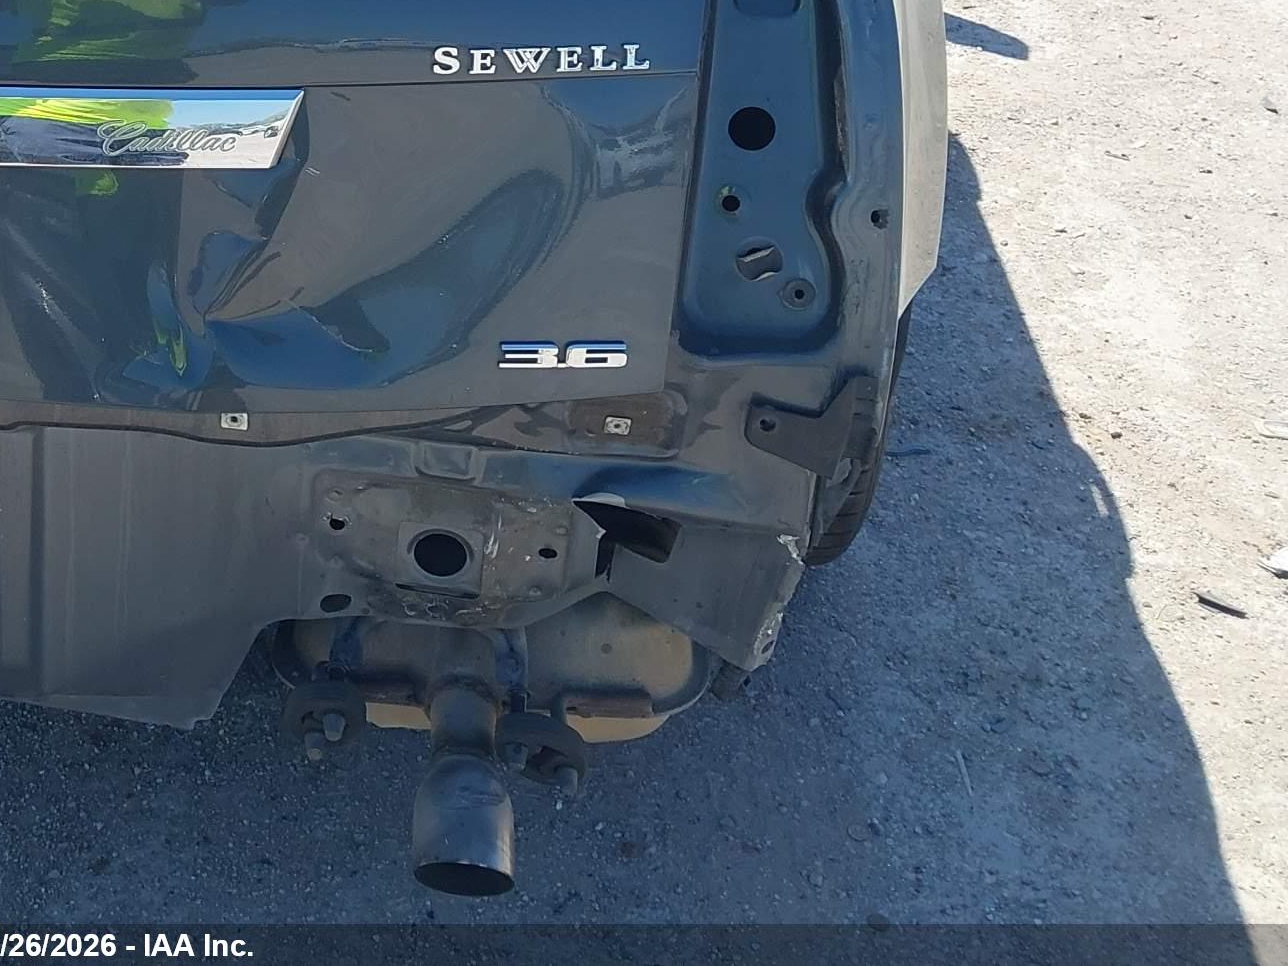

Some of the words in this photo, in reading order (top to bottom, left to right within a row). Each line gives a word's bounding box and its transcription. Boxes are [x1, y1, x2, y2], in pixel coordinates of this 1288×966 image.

[432, 43, 651, 76] SEWELL
[96, 119, 238, 157] Cadillac
[498, 341, 629, 369] 3.6
